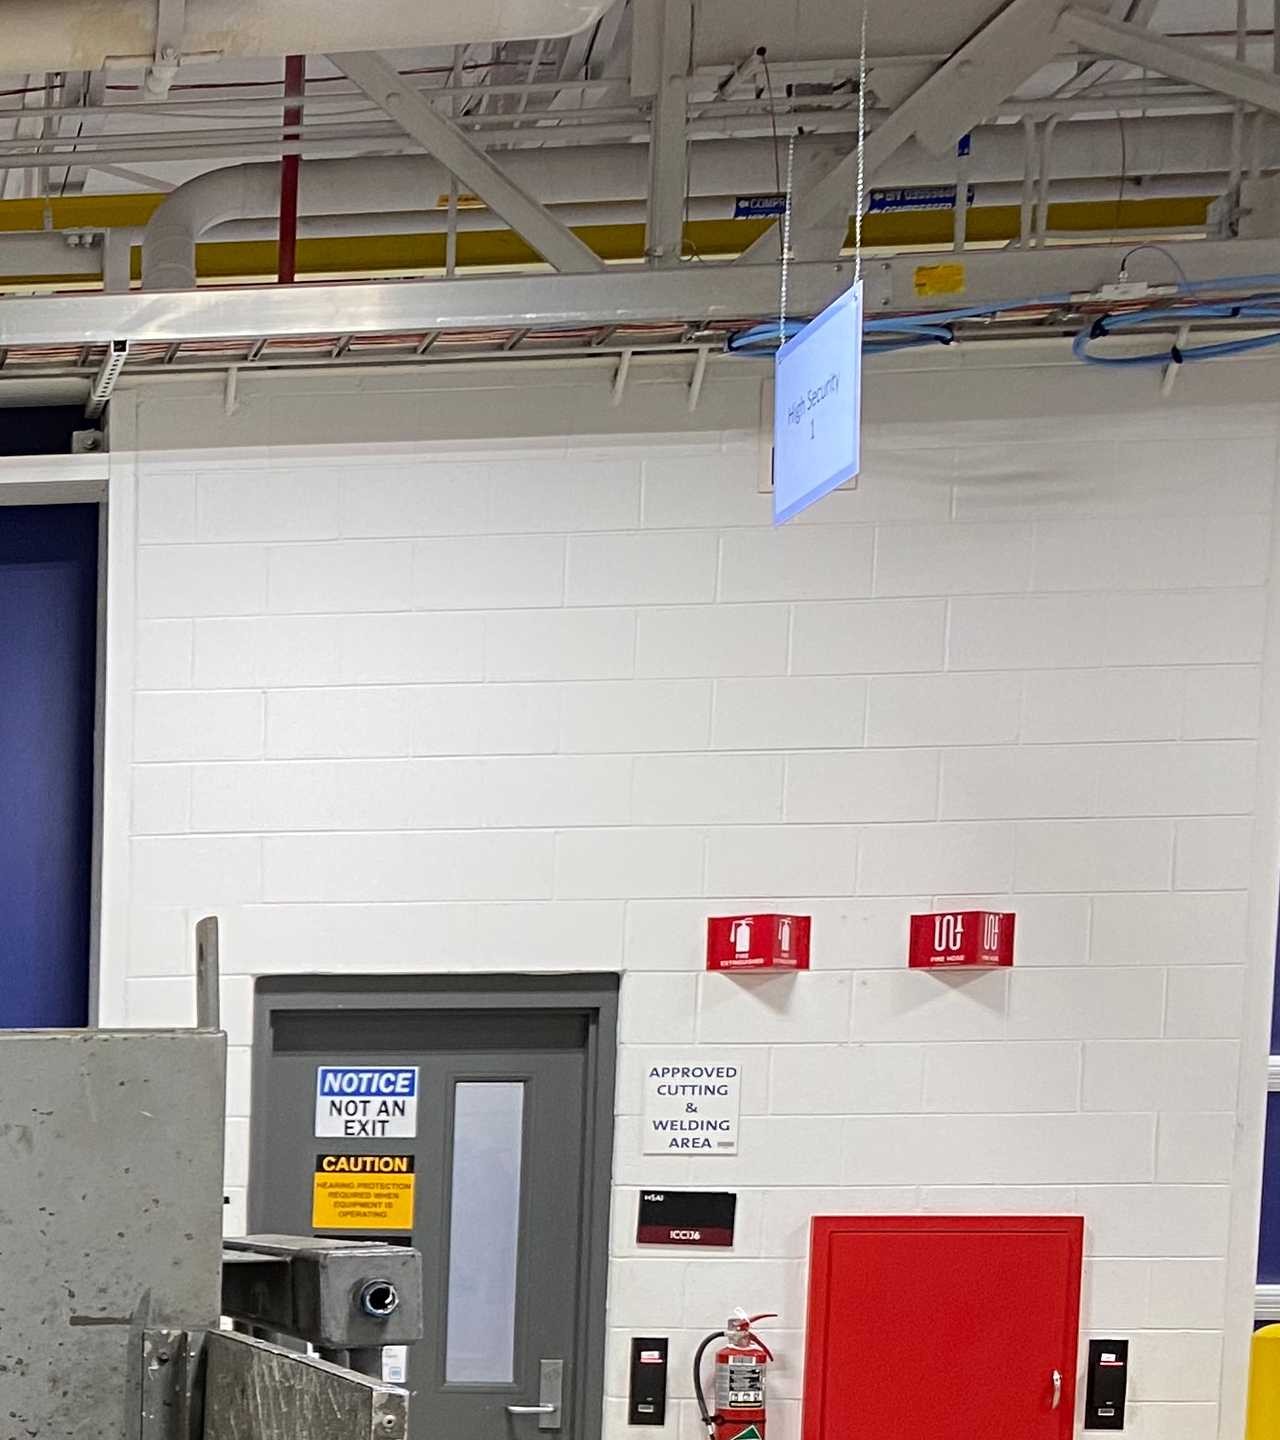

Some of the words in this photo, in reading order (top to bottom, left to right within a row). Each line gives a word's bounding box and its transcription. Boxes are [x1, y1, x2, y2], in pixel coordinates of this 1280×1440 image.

[648, 1067, 737, 1078] APPROVED
[323, 1072, 412, 1094] NOTICE
[656, 1084, 729, 1096] CUTTING
[329, 1100, 371, 1117] NOT
[376, 1100, 406, 1117] AN
[685, 1102, 698, 1114] &
[344, 1120, 390, 1137] EXIT
[652, 1120, 731, 1132] WELDING
[668, 1137, 713, 1149] AREA
[321, 1156, 408, 1172] CAUTION
